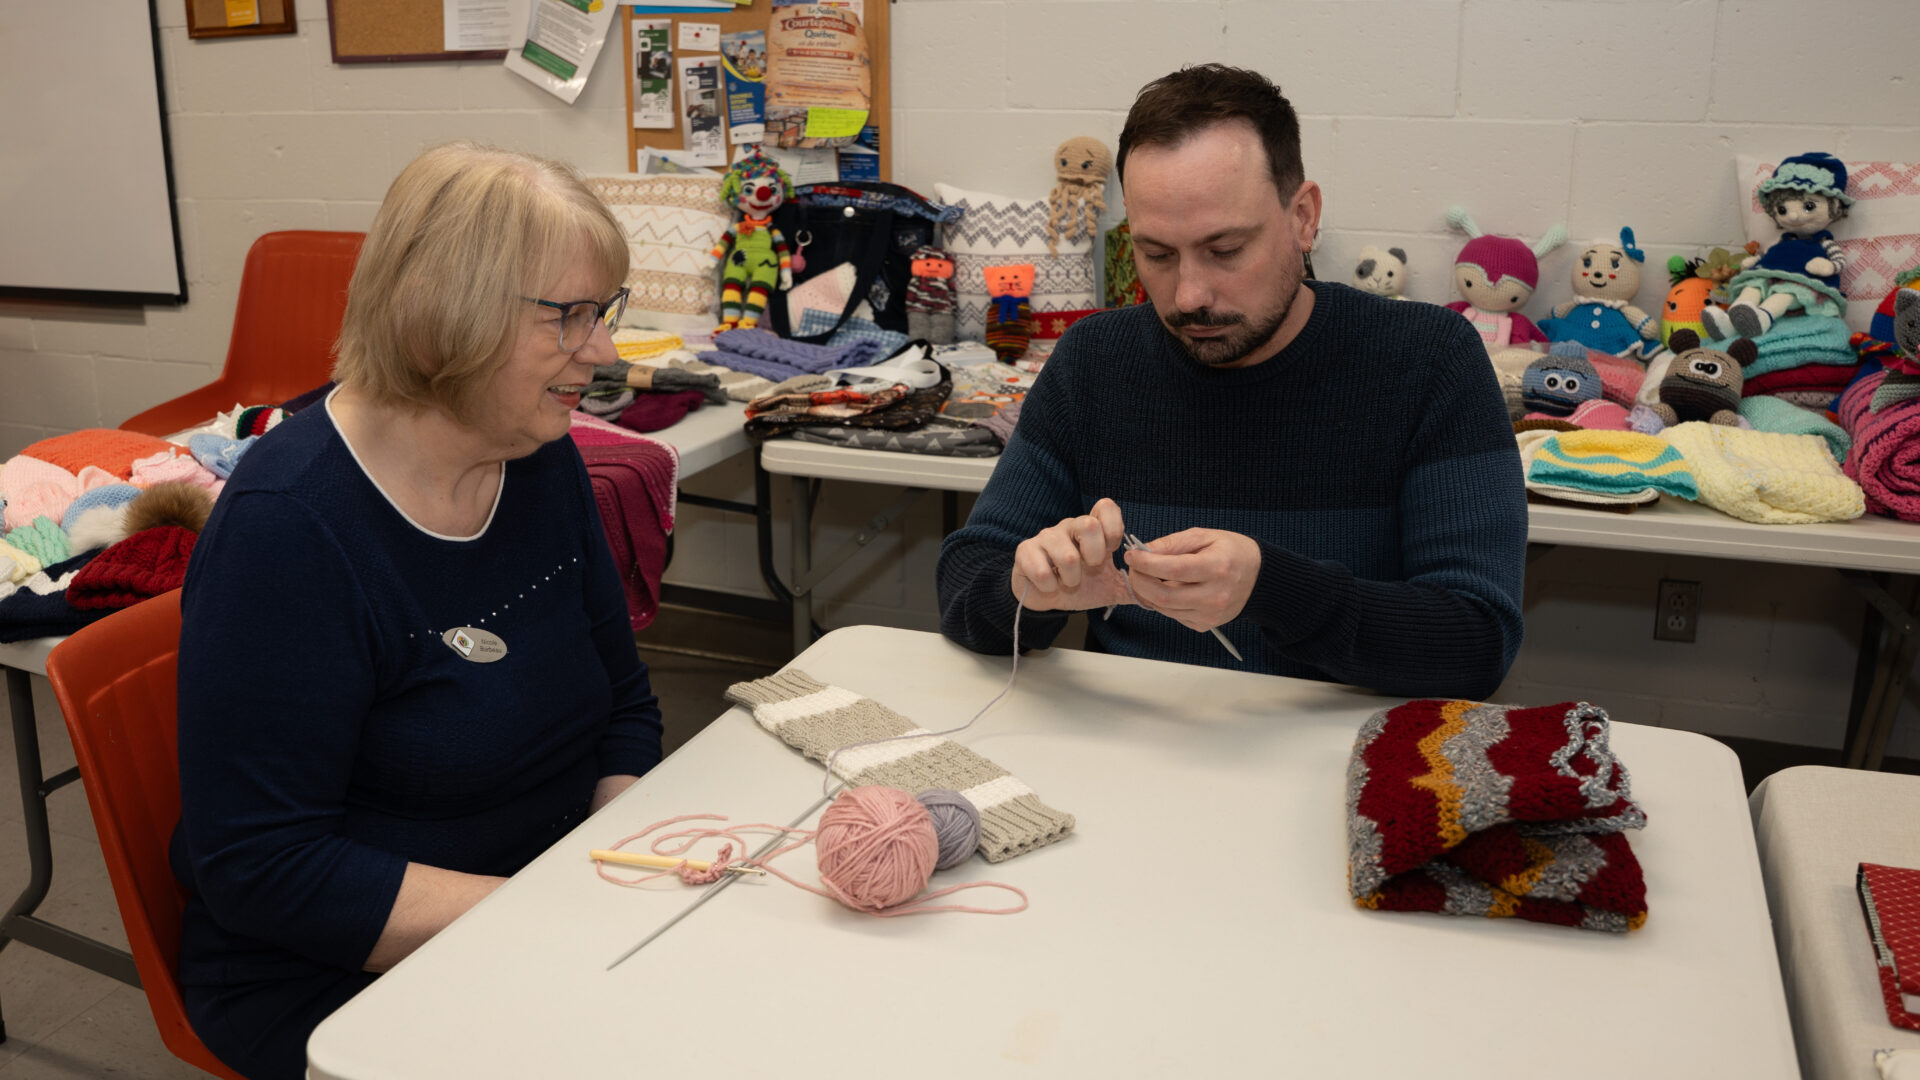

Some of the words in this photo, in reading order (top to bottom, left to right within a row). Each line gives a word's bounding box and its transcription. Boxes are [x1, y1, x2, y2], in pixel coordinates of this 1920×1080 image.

[816, 6, 837, 15] Salon
[785, 18, 849, 31] Courtepointe
[804, 29, 837, 39] Québec
